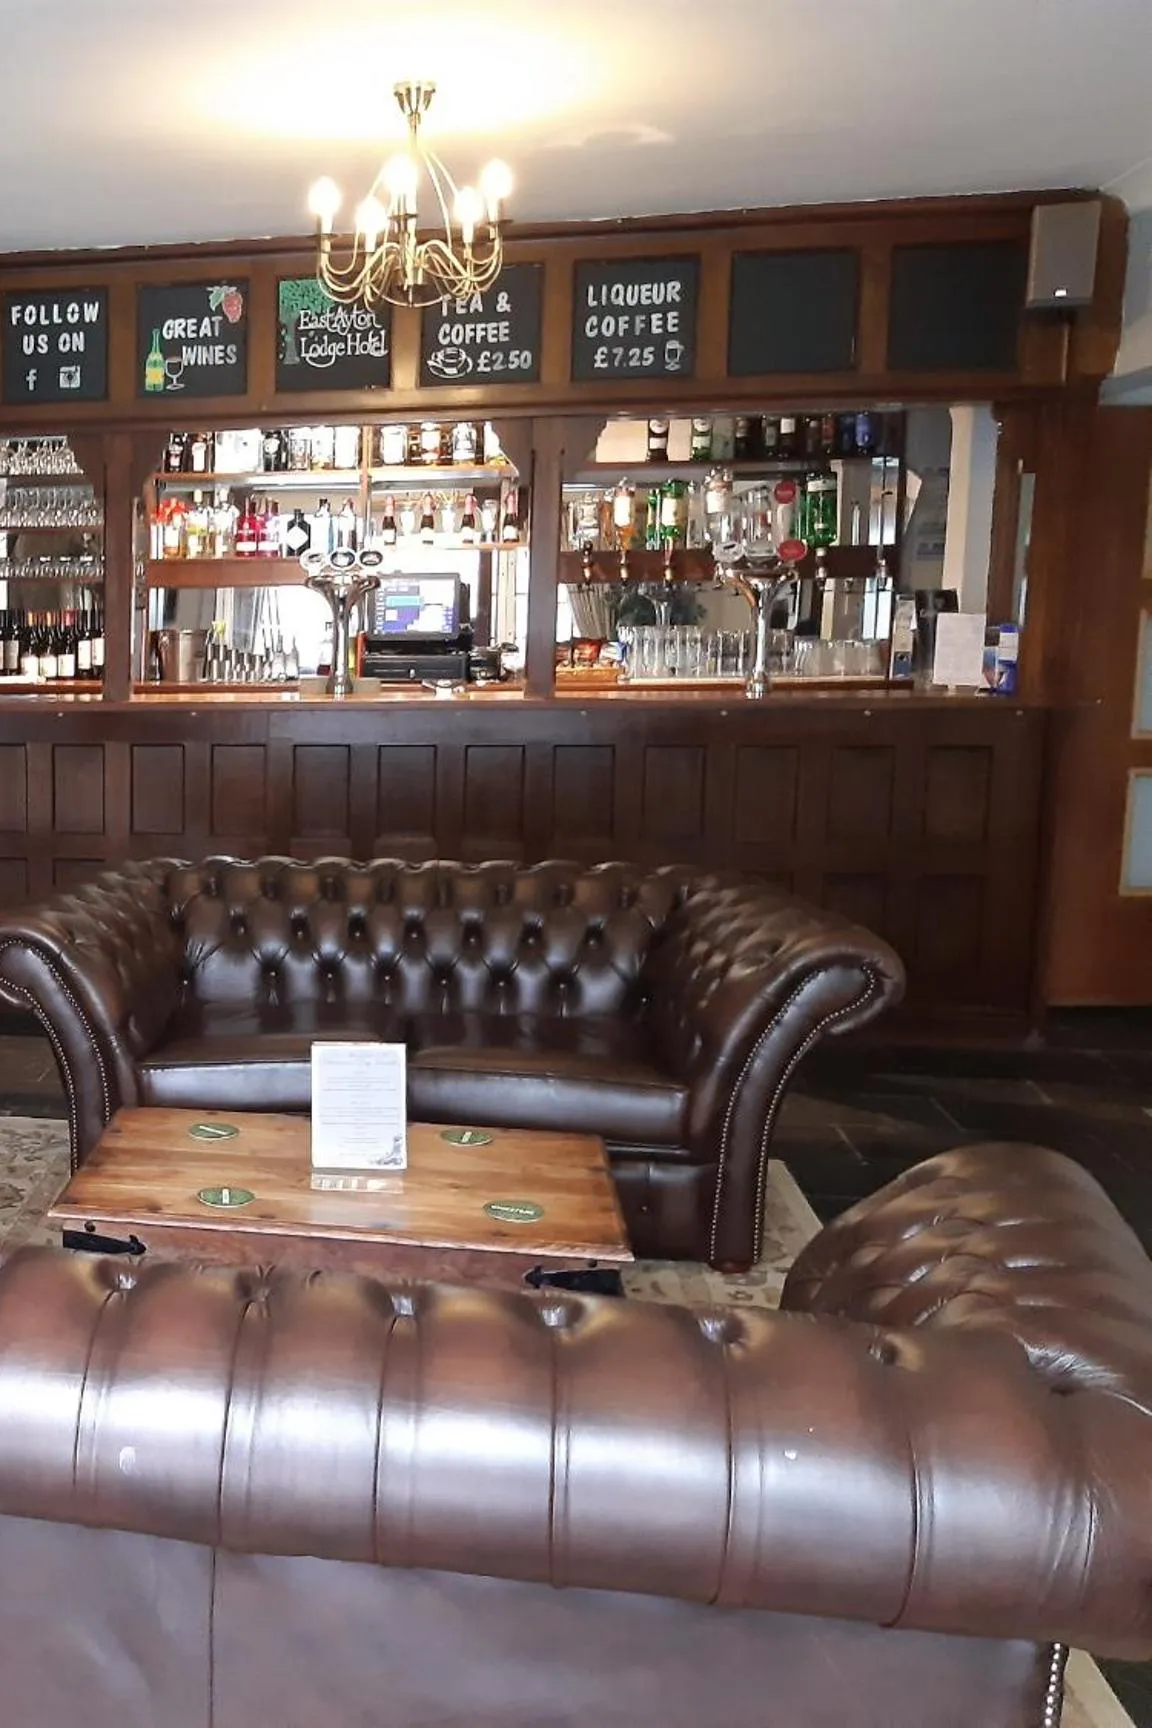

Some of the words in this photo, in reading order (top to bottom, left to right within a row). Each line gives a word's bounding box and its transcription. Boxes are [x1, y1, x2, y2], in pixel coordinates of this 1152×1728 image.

[495, 291, 511, 313] &
[587, 280, 681, 307] LIQUEUR
[10, 301, 99, 326] FOLLOW
[297, 309, 337, 333] East
[332, 303, 382, 336] Ayton
[585, 311, 679, 338] COFFEE
[162, 315, 224, 340] GREAT
[437, 321, 510, 346] COFFEE
[22, 333, 49, 355] US
[58, 331, 85, 353] ON
[181, 343, 238, 367] WINES
[300, 335, 346, 368] Lodge
[346, 329, 389, 357] Hotel
[593, 346, 656, 369] £7.25
